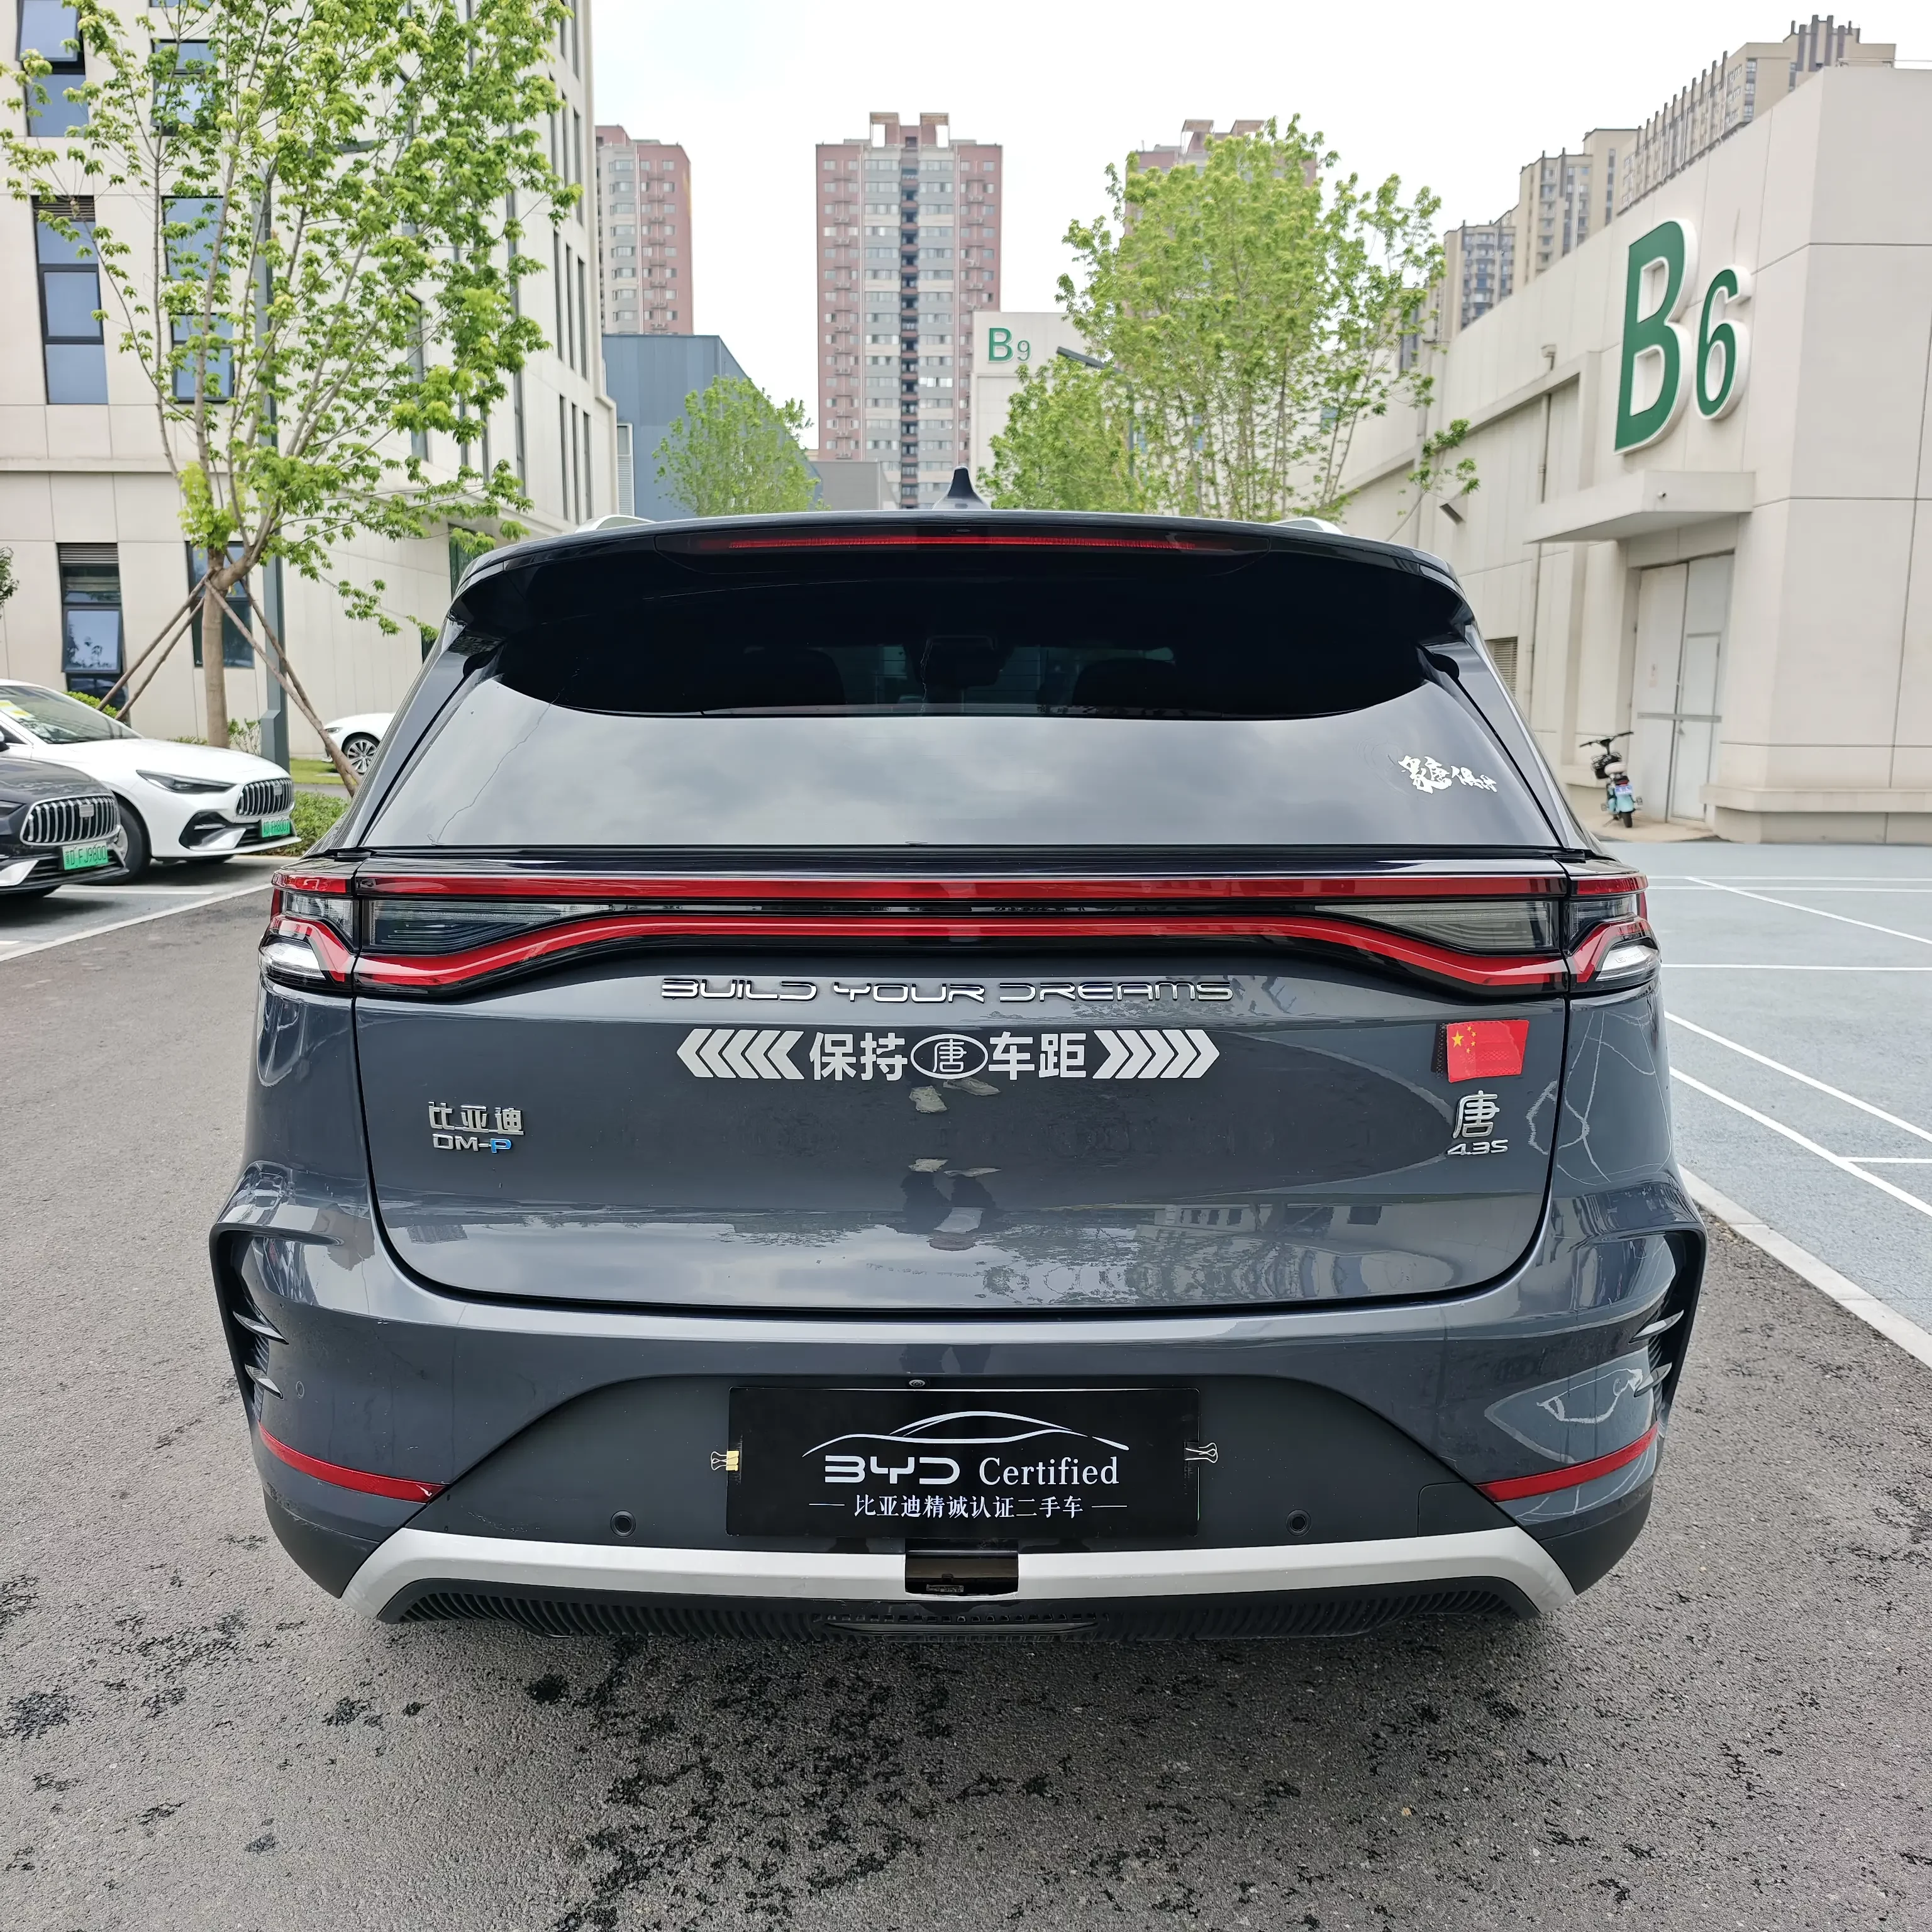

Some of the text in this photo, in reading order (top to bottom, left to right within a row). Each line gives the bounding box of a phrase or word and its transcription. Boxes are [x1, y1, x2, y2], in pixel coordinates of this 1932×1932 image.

[988, 327, 1031, 363] B9
[1614, 219, 1753, 456] B6
[662, 977, 1233, 1004] BUILD YOUR DREAMS
[428, 1101, 525, 1135] 比亚迪
[1453, 1090, 1501, 1139] 唐
[433, 1133, 511, 1153] DM-P
[1447, 1139, 1509, 1156] 4.3S
[824, 1456, 1119, 1487] BYD Certified
[853, 1495, 1084, 1519] 比亚迪精诚认证二手车
